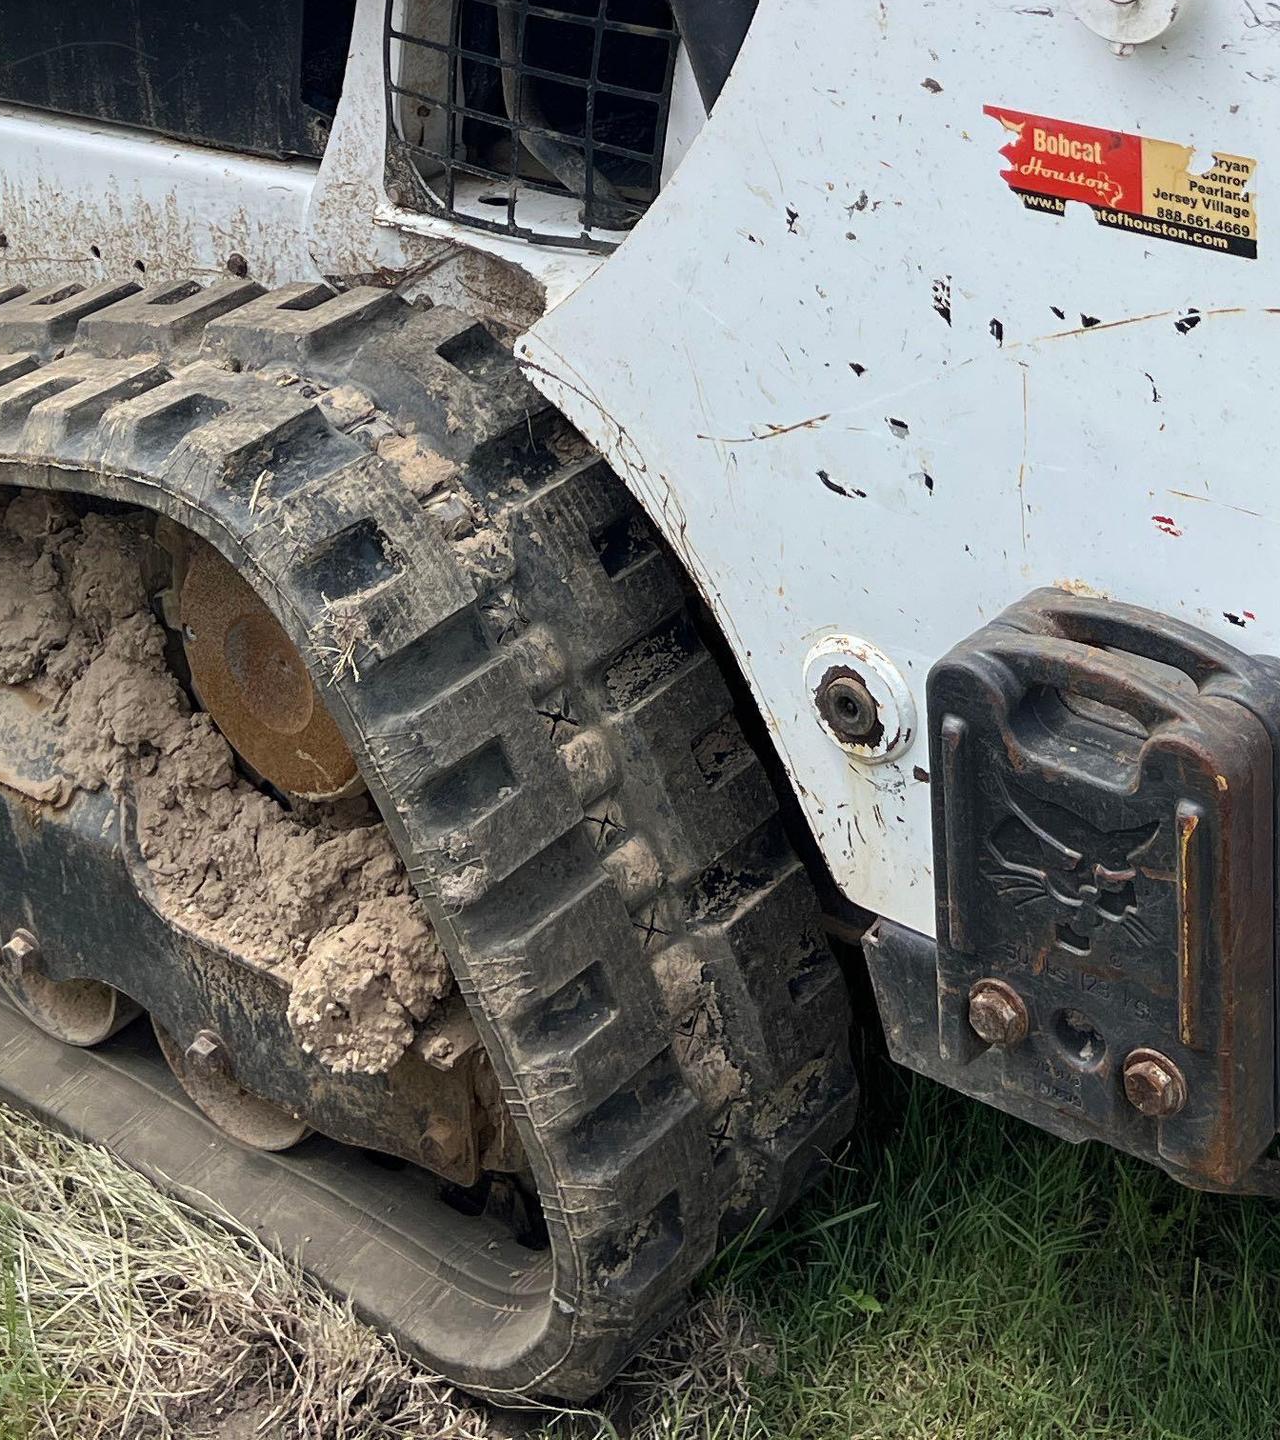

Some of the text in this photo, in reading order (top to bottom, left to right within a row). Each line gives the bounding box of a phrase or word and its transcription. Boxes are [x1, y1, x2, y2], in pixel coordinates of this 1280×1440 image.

[1032, 127, 1102, 165] Bobcat
[1020, 156, 1112, 192] Houston
[1152, 187, 1251, 219] Jersey Village
[1156, 206, 1251, 238] 888.661.4669
